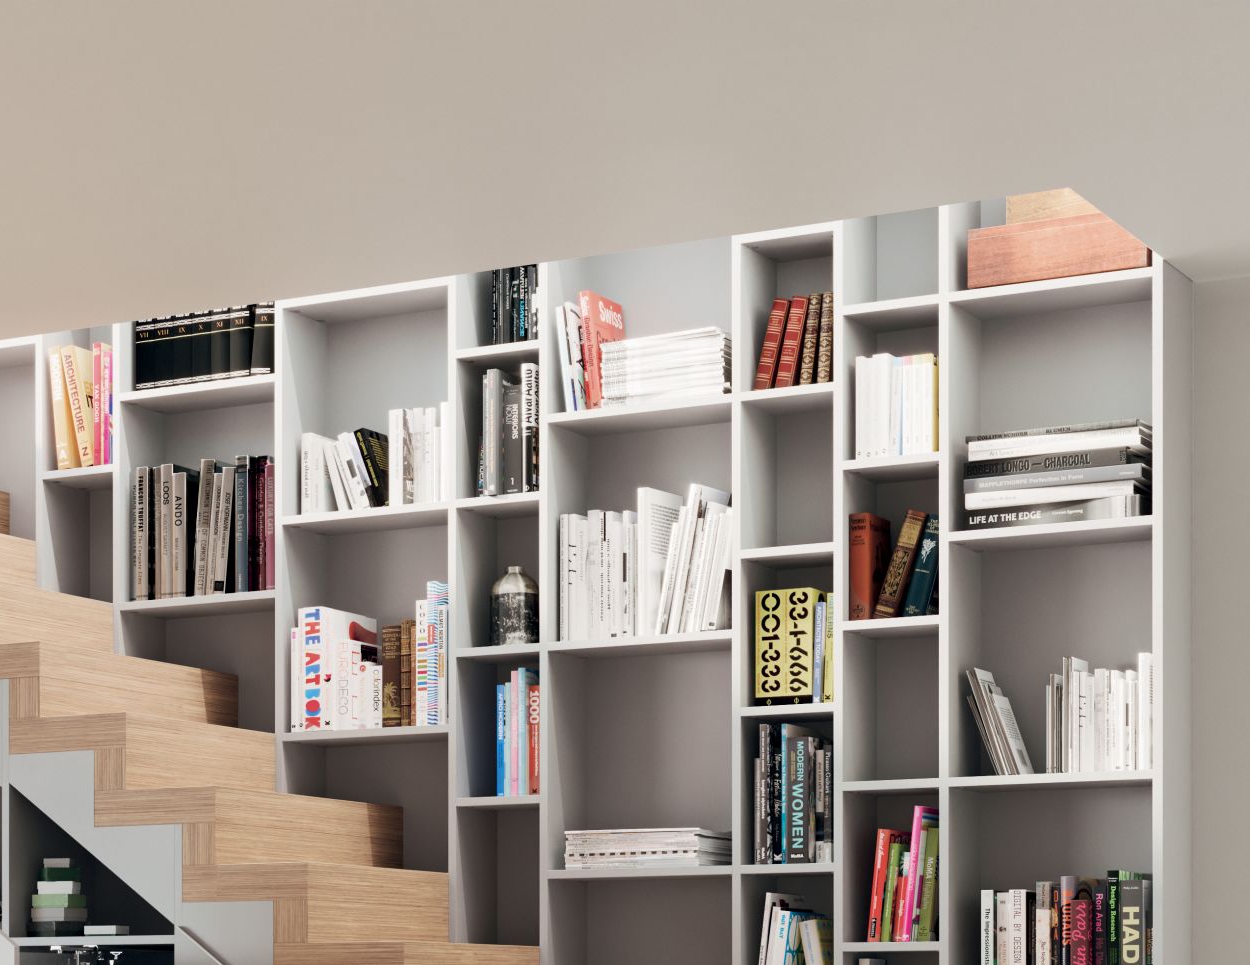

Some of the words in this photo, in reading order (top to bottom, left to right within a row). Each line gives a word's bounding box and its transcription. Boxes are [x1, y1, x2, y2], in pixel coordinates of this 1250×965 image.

[598, 300, 623, 330] Swiss
[63, 354, 86, 433] ARCHITECTURE
[1003, 459, 1030, 473] LONGO
[1044, 453, 1091, 469] CHARCOAL
[162, 481, 170, 505] LOOS
[237, 478, 245, 511] Kitchen
[174, 495, 183, 527] ANDO
[969, 515, 987, 525] LIFE
[987, 514, 999, 523] AT
[1000, 512, 1017, 522] THE
[1018, 510, 1042, 520] EDGE
[236, 513, 245, 542] Design
[199, 539, 207, 562] COMMON
[304, 608, 321, 646] THE
[529, 690, 540, 724] 1000
[796, 741, 804, 781] MODERN
[824, 751, 832, 771] Picasso
[791, 783, 804, 849] WOMEN
[926, 856, 934, 879] MoMA
[1013, 890, 1022, 920] DIGITAL
[1095, 893, 1103, 911] Ron
[1109, 885, 1117, 908] Design
[1013, 924, 1022, 932] BY
[1071, 901, 1087, 944] Parr
[1095, 912, 1103, 932] Arad
[983, 920, 991, 965] Impressionists
[1013, 936, 1022, 964] DESIGN
